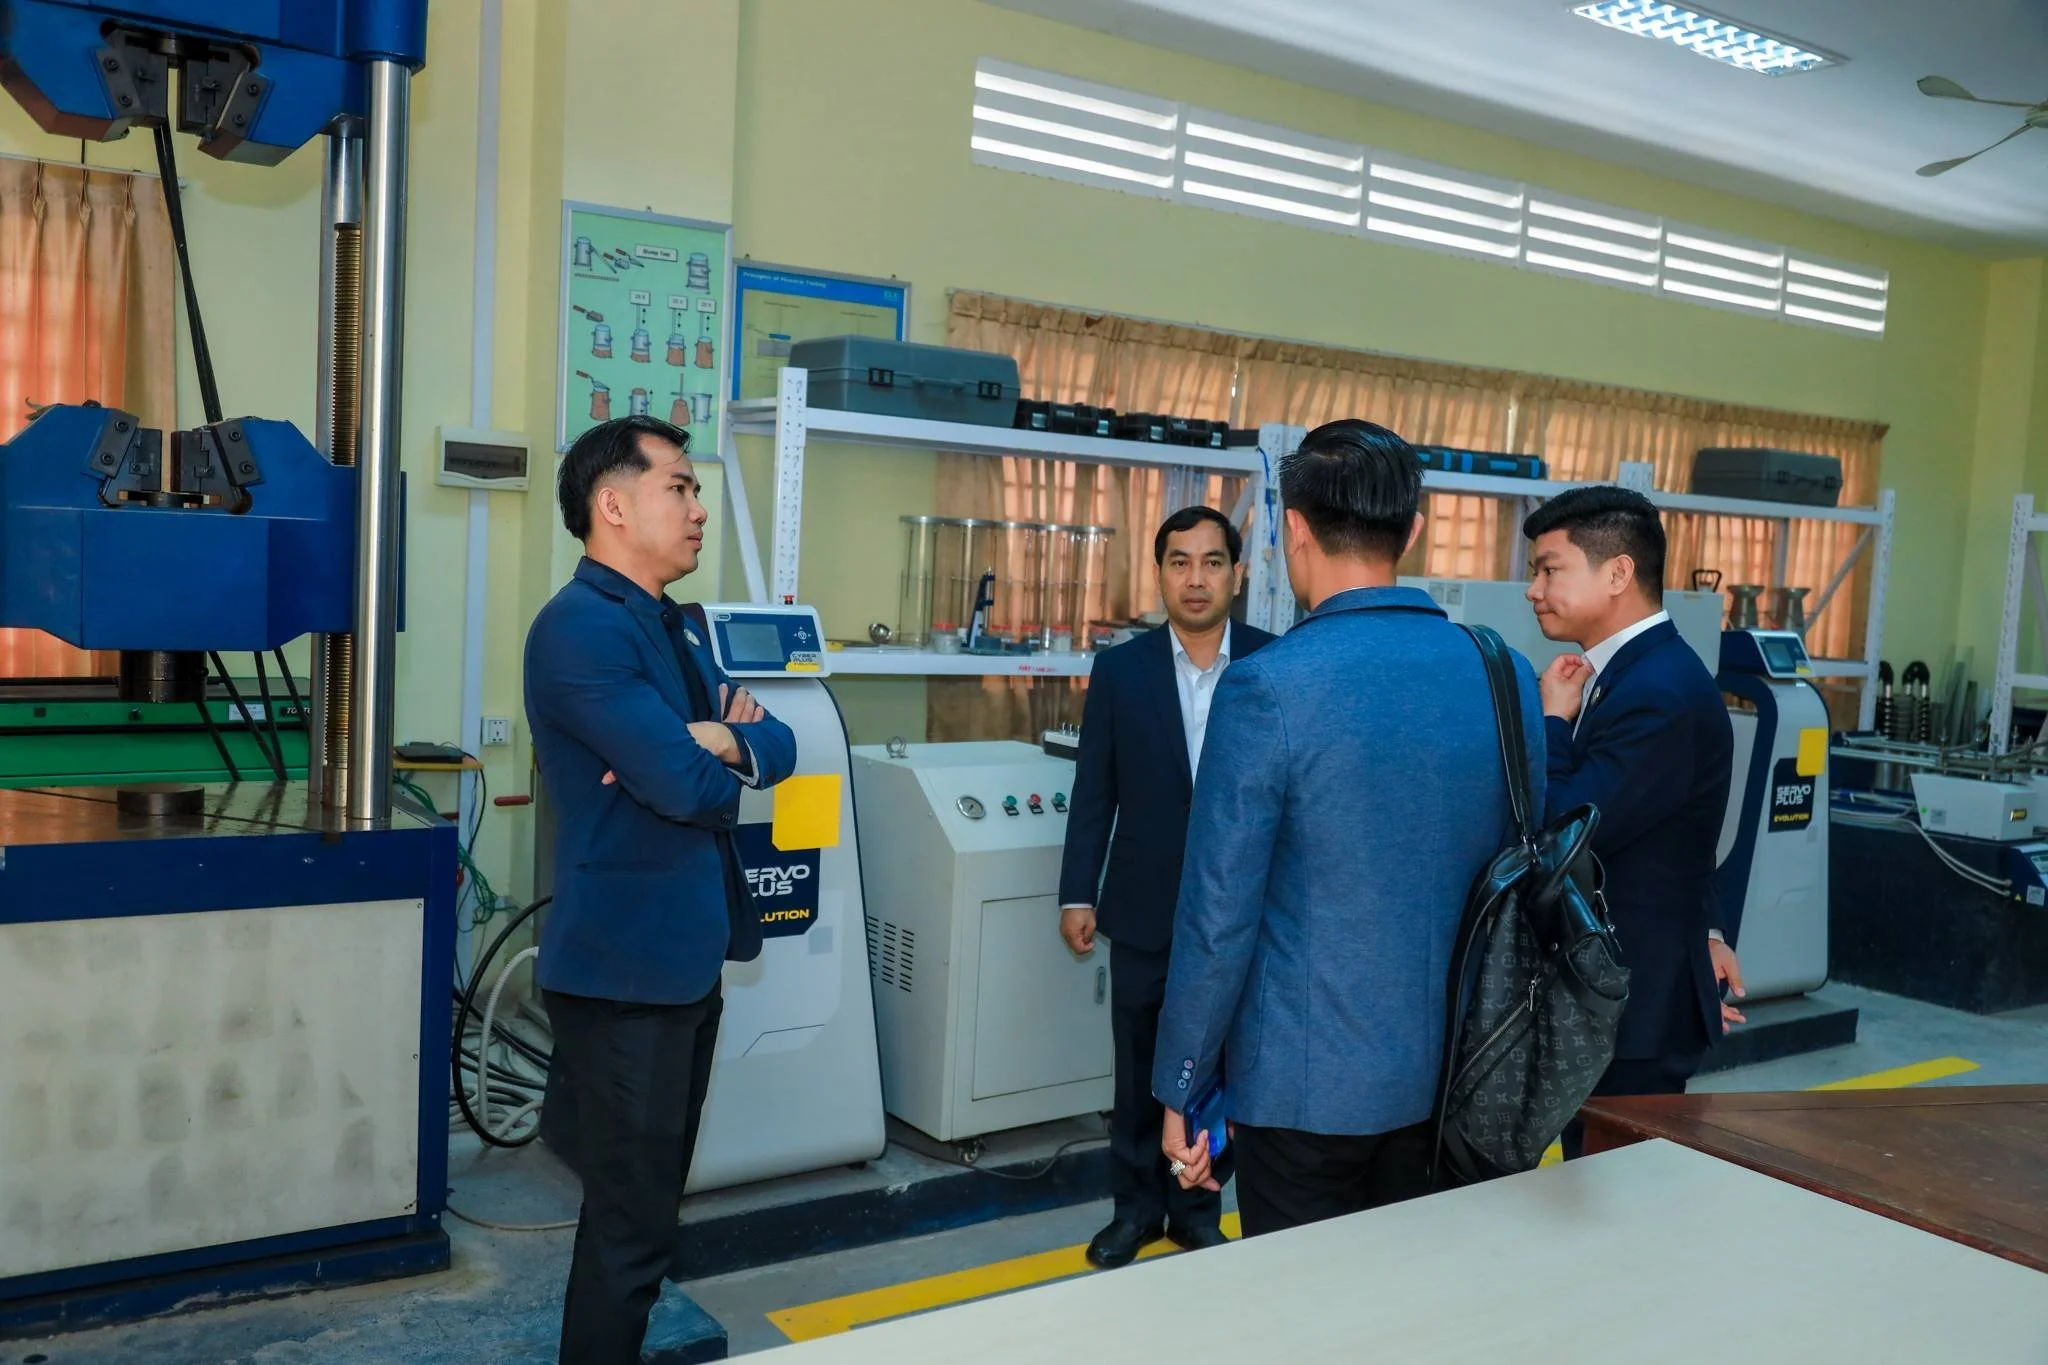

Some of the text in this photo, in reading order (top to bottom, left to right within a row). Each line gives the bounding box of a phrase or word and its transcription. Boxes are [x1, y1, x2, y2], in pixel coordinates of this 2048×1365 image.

[1776, 784, 1811, 796] SERVO
[1775, 795, 1804, 806] PLUS
[1774, 813, 1809, 823] EVOLUTION
[744, 864, 810, 883] ERVO
[752, 879, 794, 898] US
[760, 909, 810, 922] UTION
